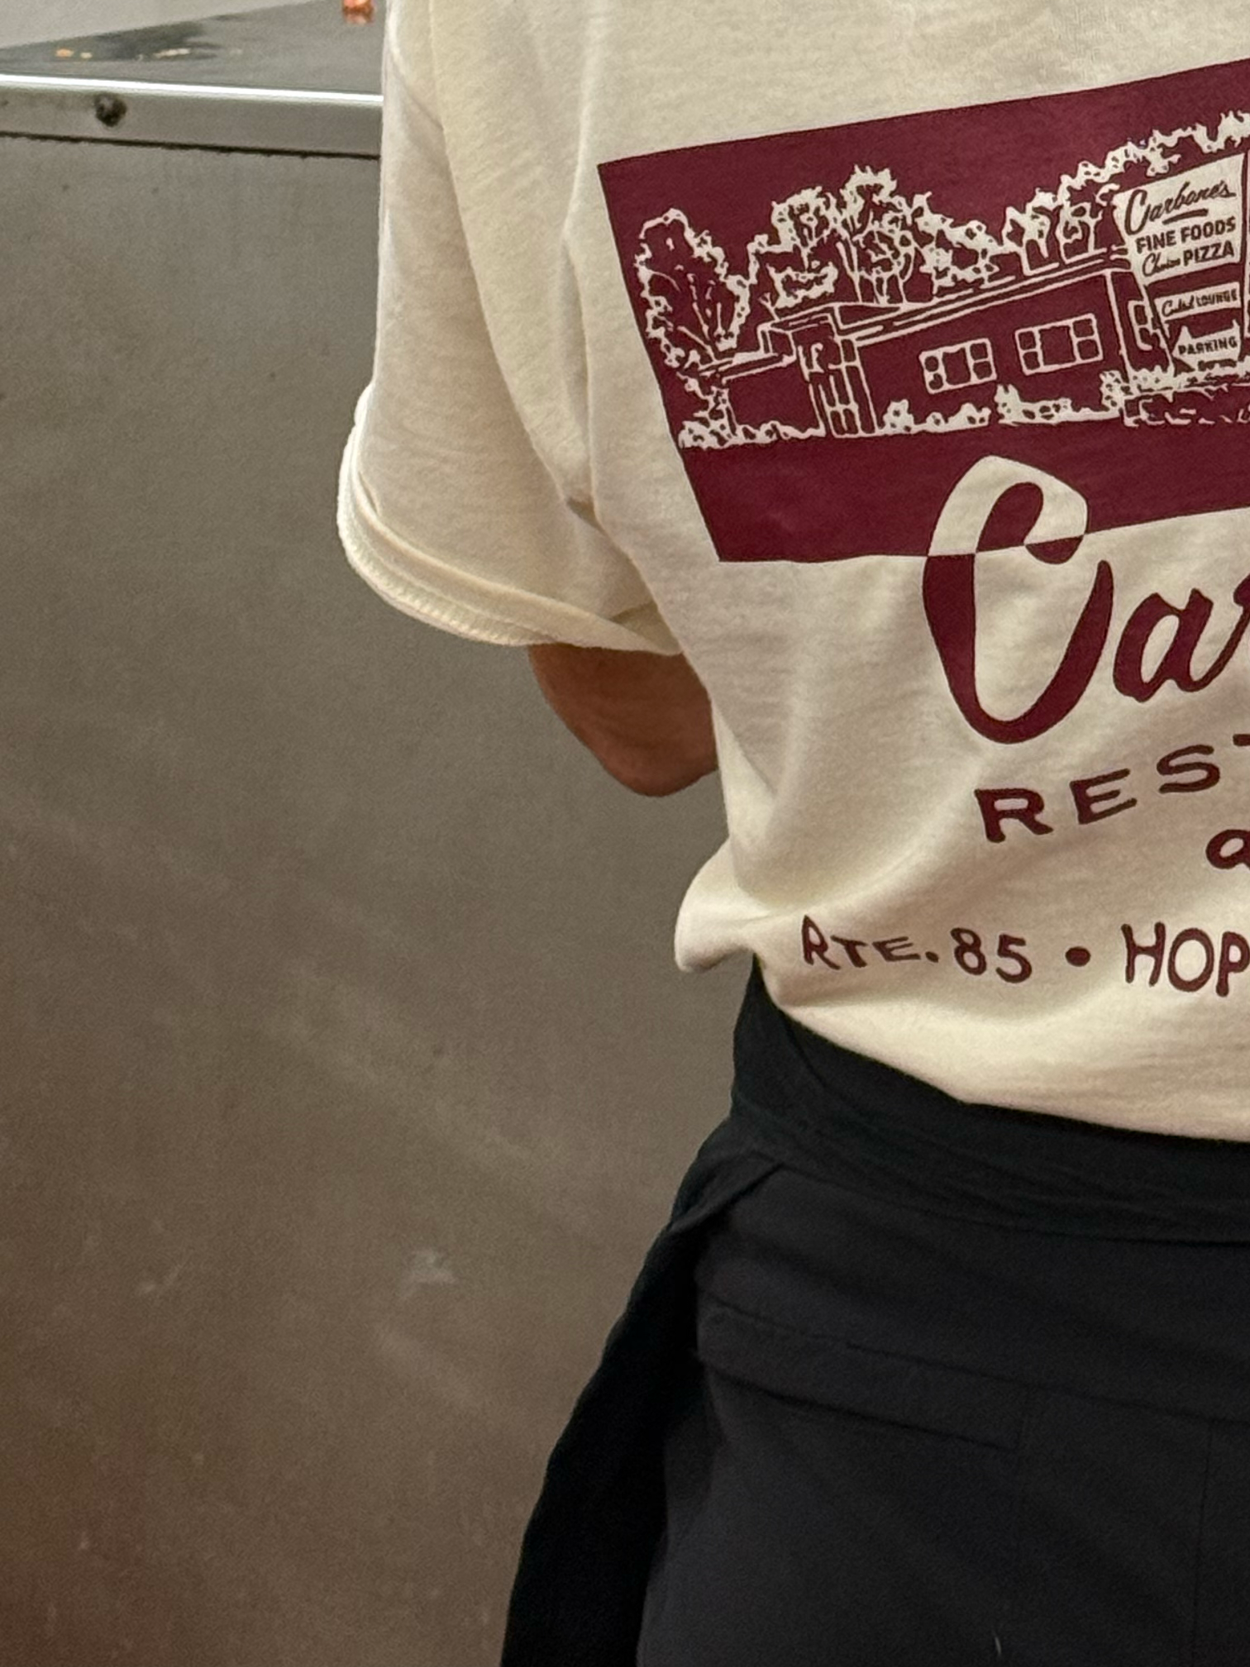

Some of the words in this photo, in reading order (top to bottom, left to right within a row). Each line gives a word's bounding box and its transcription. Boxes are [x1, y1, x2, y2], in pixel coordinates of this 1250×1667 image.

[1124, 180, 1237, 236] Carbone's
[1135, 230, 1177, 254] FINE
[1180, 216, 1236, 243] FOODS
[1183, 240, 1235, 266] PIZZA
[1196, 288, 1238, 308] LOUNGE
[1178, 336, 1238, 356] PARKING
